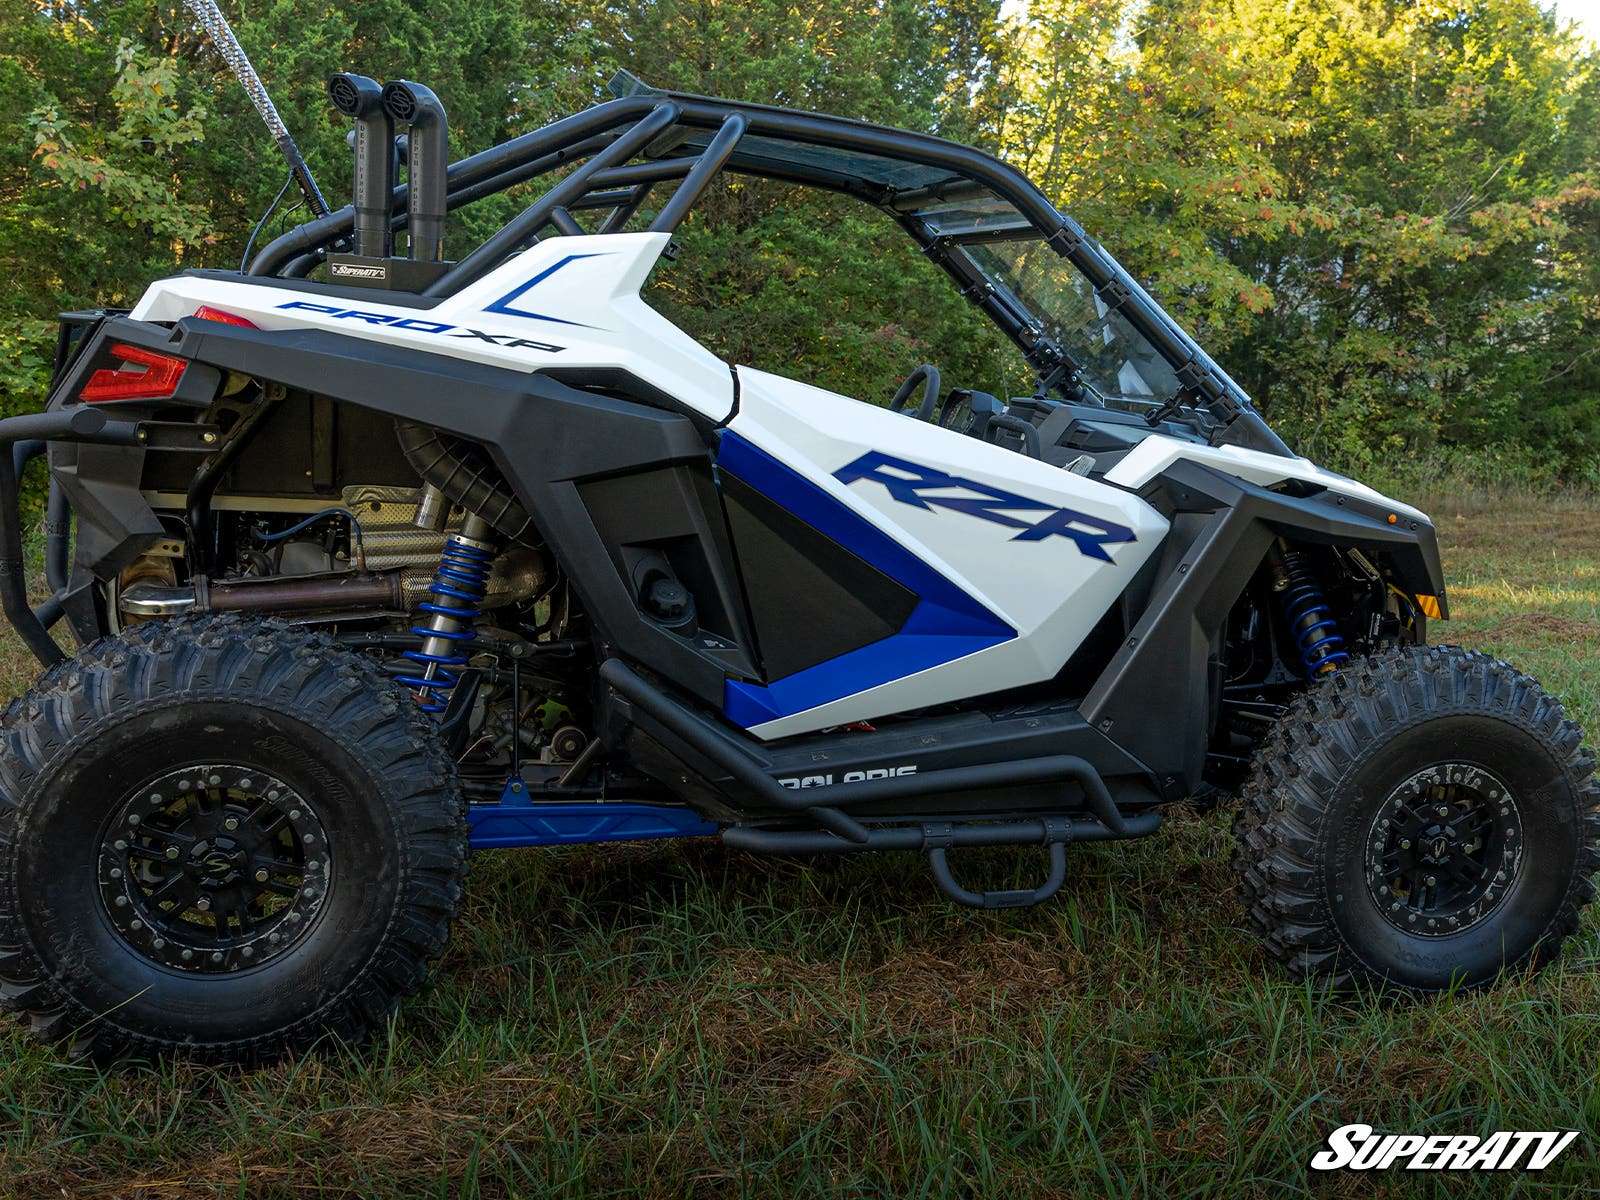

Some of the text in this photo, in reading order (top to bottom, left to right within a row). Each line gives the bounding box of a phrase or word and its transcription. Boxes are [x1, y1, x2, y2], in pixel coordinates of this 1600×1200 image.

[274, 301, 567, 353] PRO XP
[831, 450, 1138, 566] RZR
